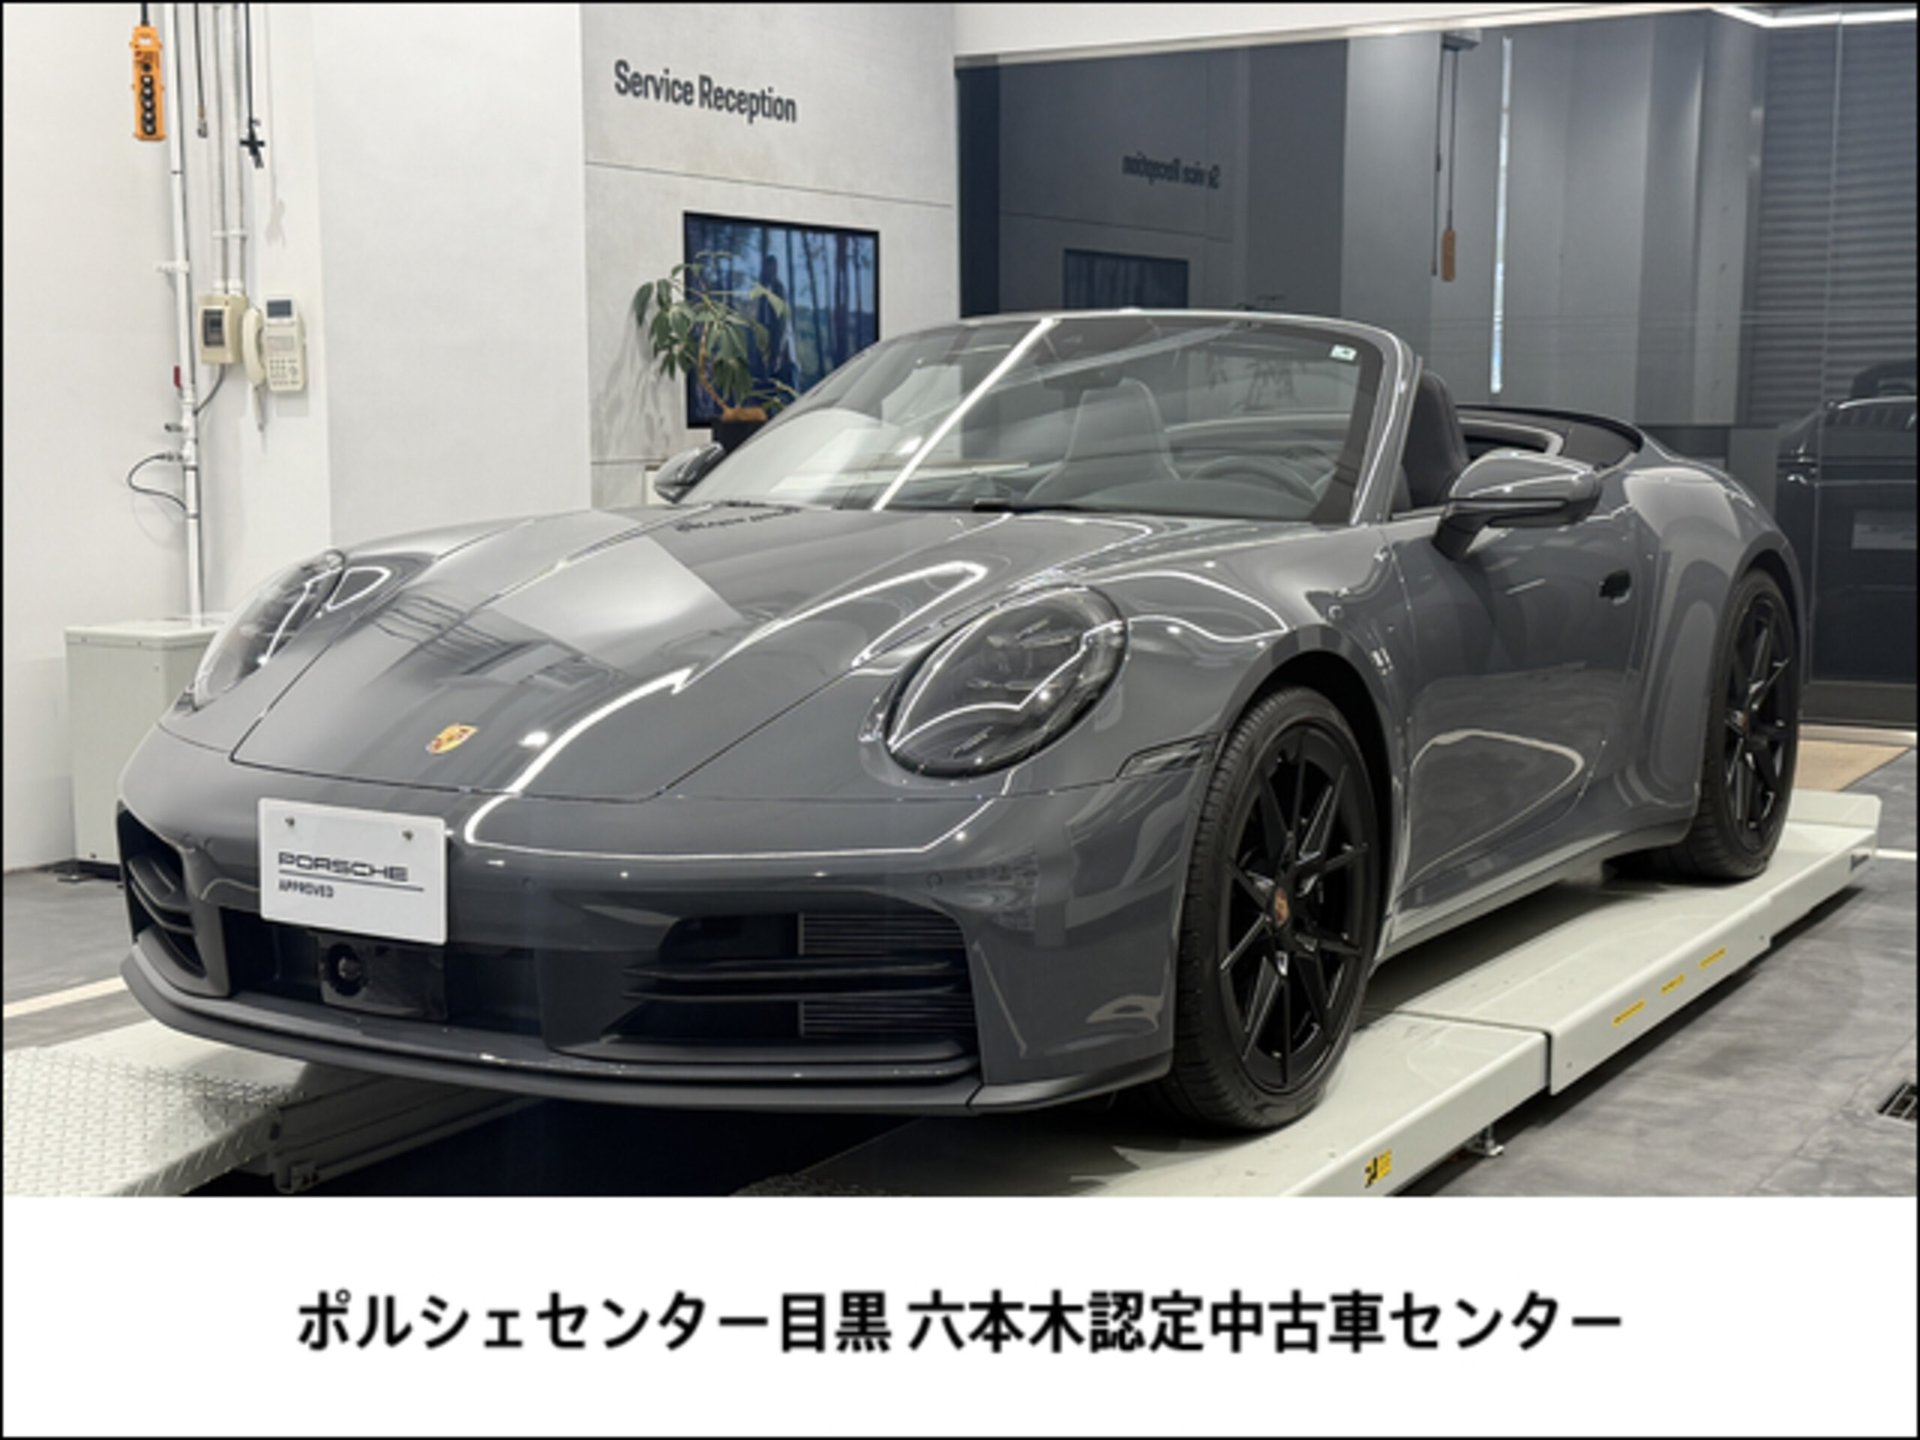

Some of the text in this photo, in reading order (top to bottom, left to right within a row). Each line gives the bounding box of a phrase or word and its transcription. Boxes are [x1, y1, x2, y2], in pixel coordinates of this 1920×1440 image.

[614, 59, 797, 124] Service Reception
[278, 852, 408, 882] PORSCHE
[278, 880, 334, 898] APPROVED
